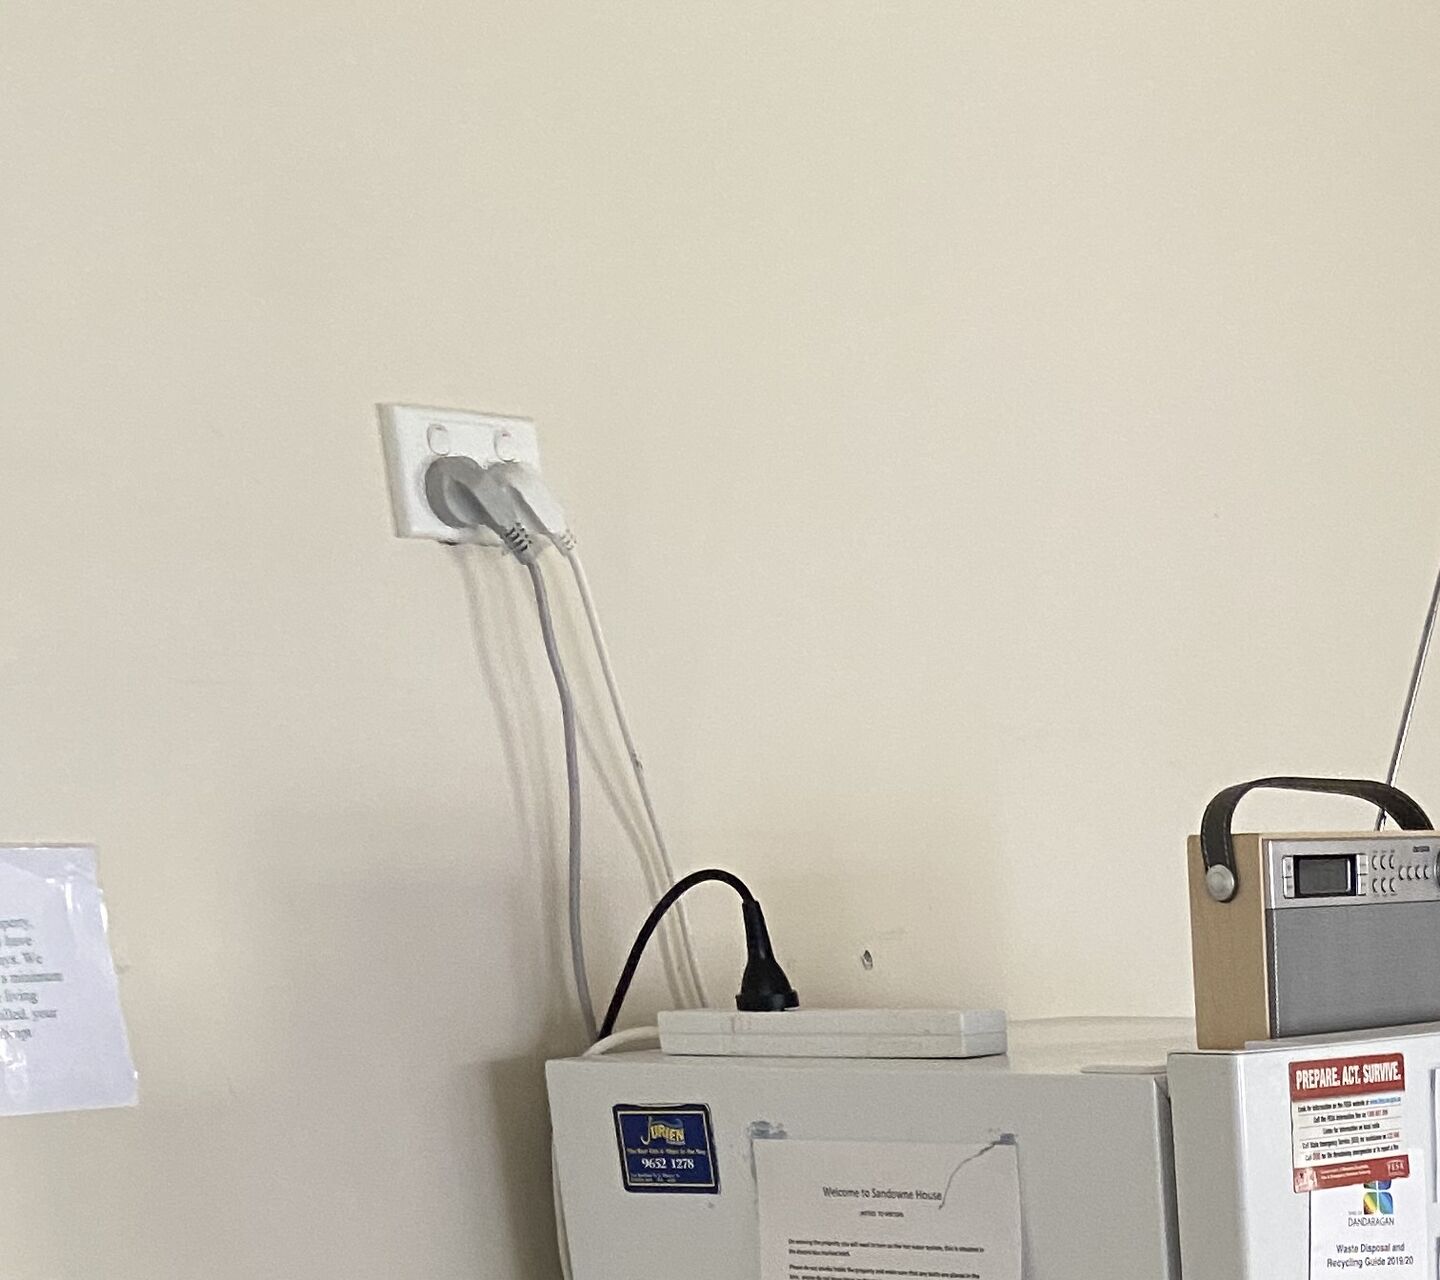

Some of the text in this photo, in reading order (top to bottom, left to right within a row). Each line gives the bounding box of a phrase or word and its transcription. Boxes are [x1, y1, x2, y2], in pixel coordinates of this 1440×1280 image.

[1296, 1061, 1402, 1090] PREPARE. ACT. SURVIVE.
[671, 1158, 695, 1169] 1278
[822, 1186, 860, 1198] Welcome
[862, 1188, 870, 1198] to
[916, 1190, 942, 1200] House
[1348, 1217, 1395, 1227] DANDARAGAN
[1336, 1242, 1405, 1254] Waste Disposal and
[1326, 1258, 1363, 1269] Recycling
[1364, 1256, 1386, 1266] Guide
